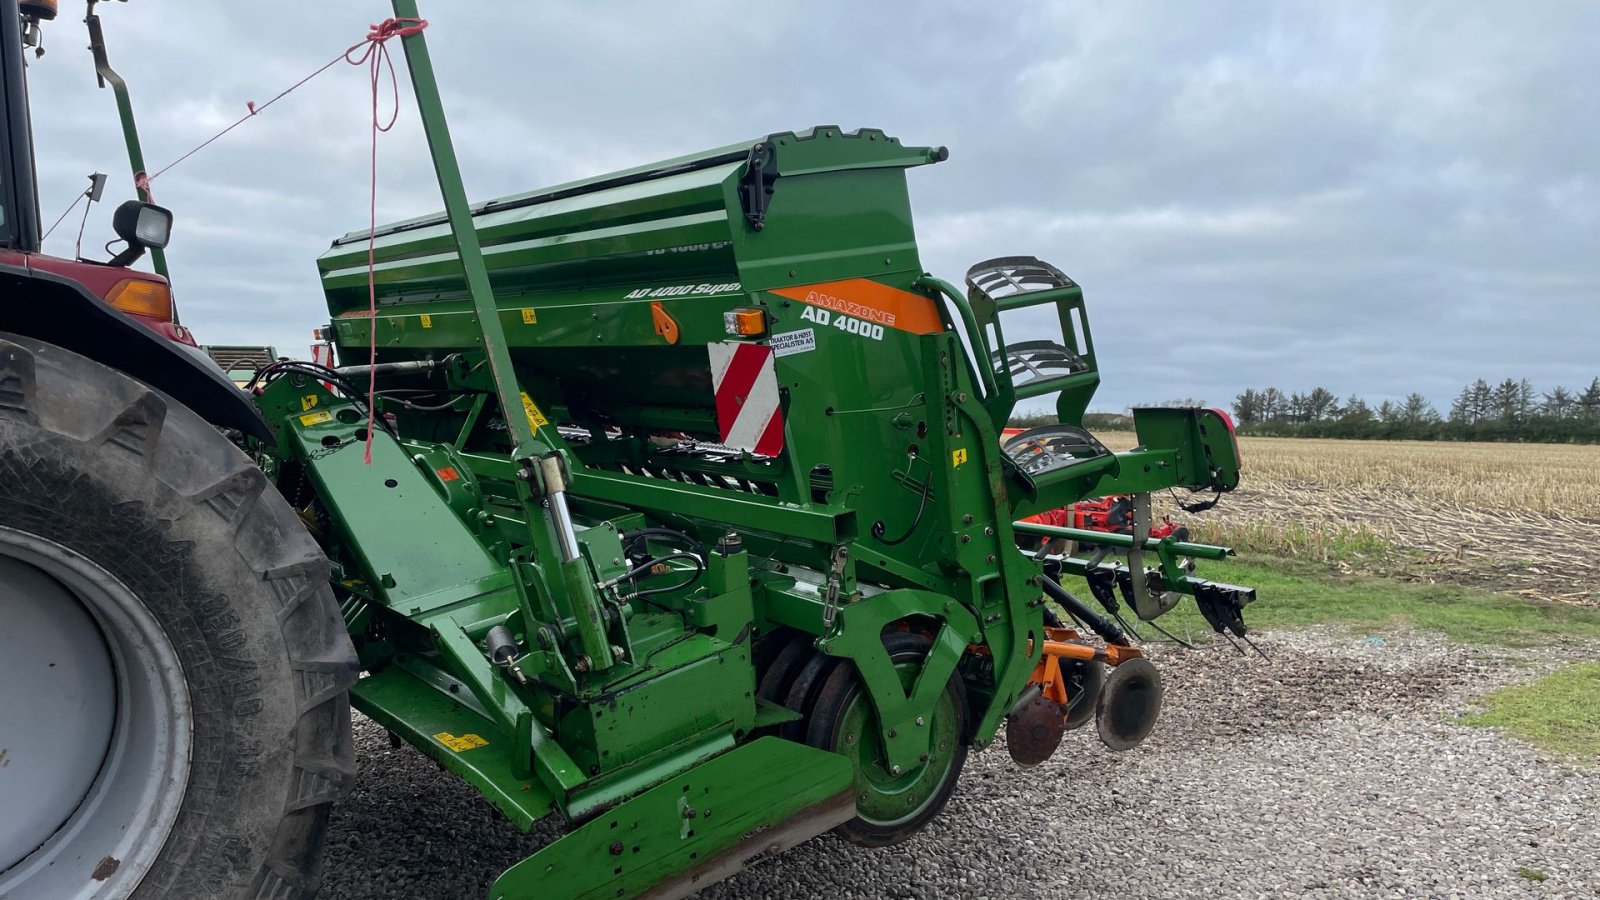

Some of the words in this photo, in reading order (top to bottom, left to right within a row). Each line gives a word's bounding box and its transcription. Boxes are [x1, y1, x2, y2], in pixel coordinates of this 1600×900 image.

[623, 288, 652, 299] AD
[648, 285, 695, 297] 4000
[691, 282, 741, 295] Super
[800, 305, 830, 326] AD
[833, 315, 884, 340] 4000
[805, 291, 896, 326] AMAZONE
